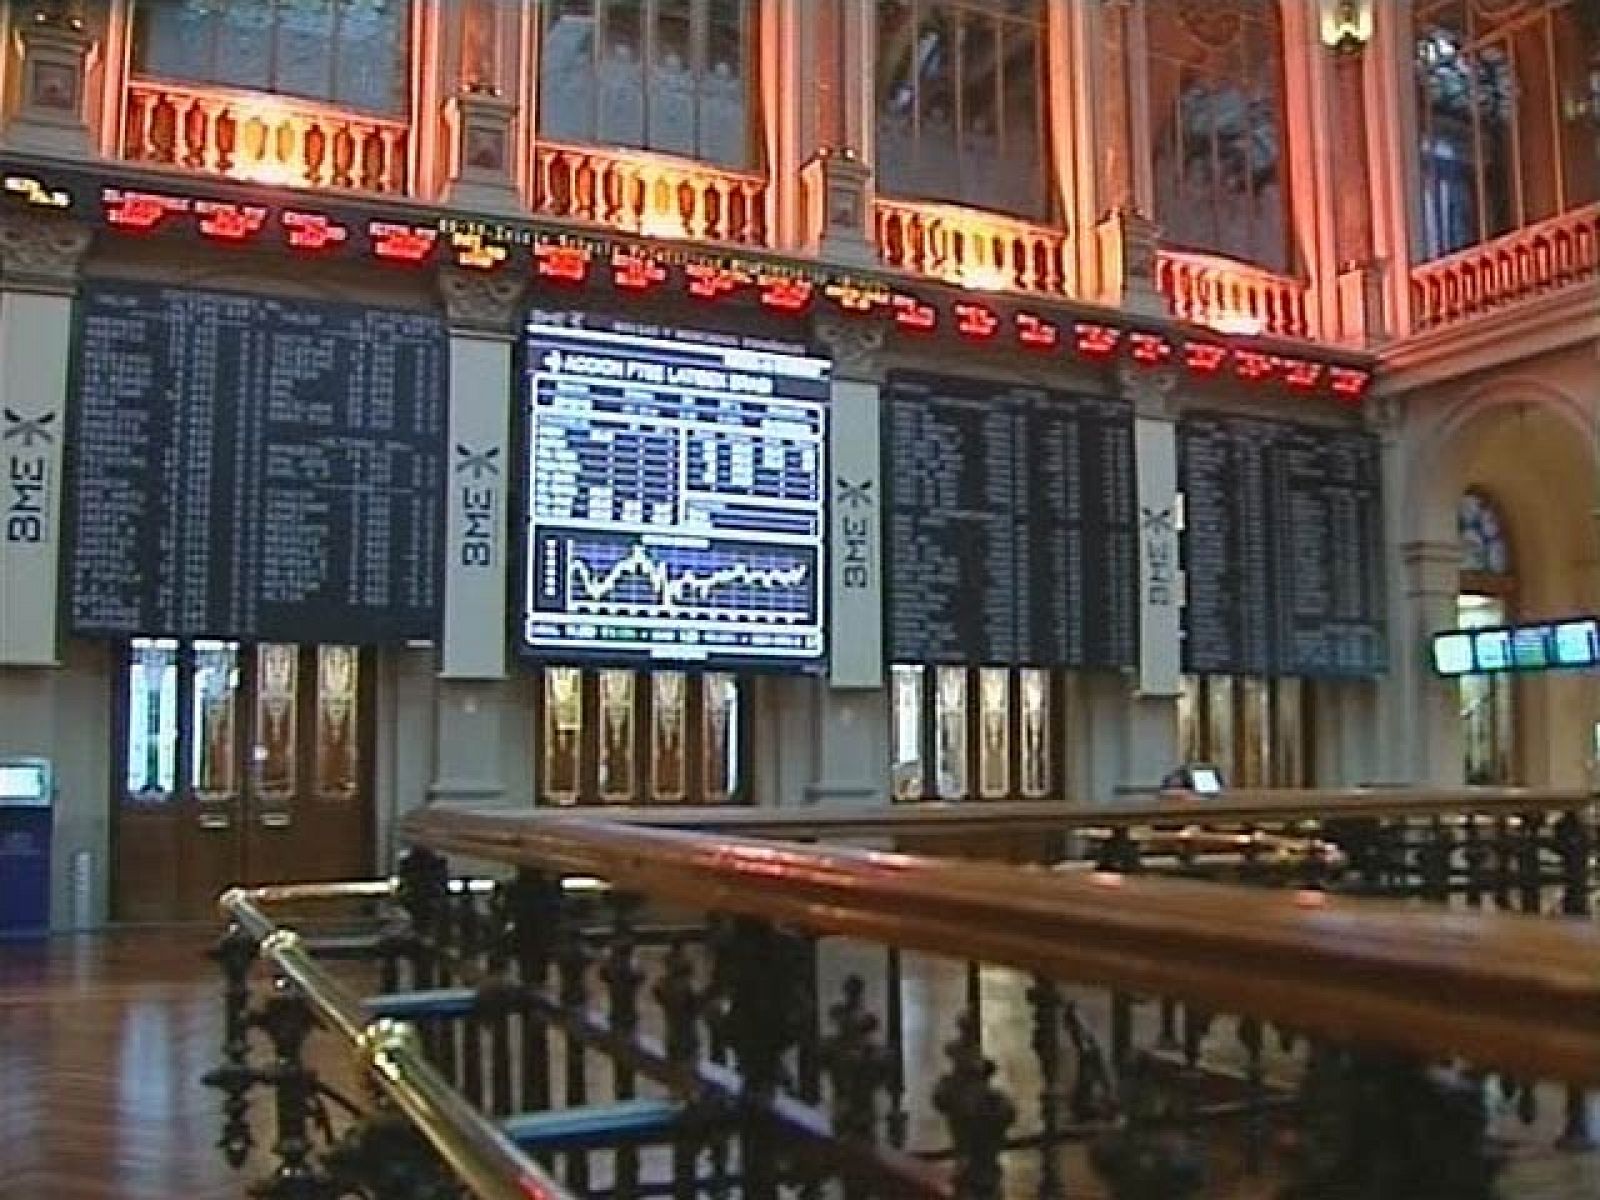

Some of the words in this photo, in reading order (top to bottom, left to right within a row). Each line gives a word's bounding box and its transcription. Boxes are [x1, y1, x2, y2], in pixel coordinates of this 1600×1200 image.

[8, 456, 44, 542] BME
[462, 487, 491, 566] BME
[844, 516, 866, 588] BME
